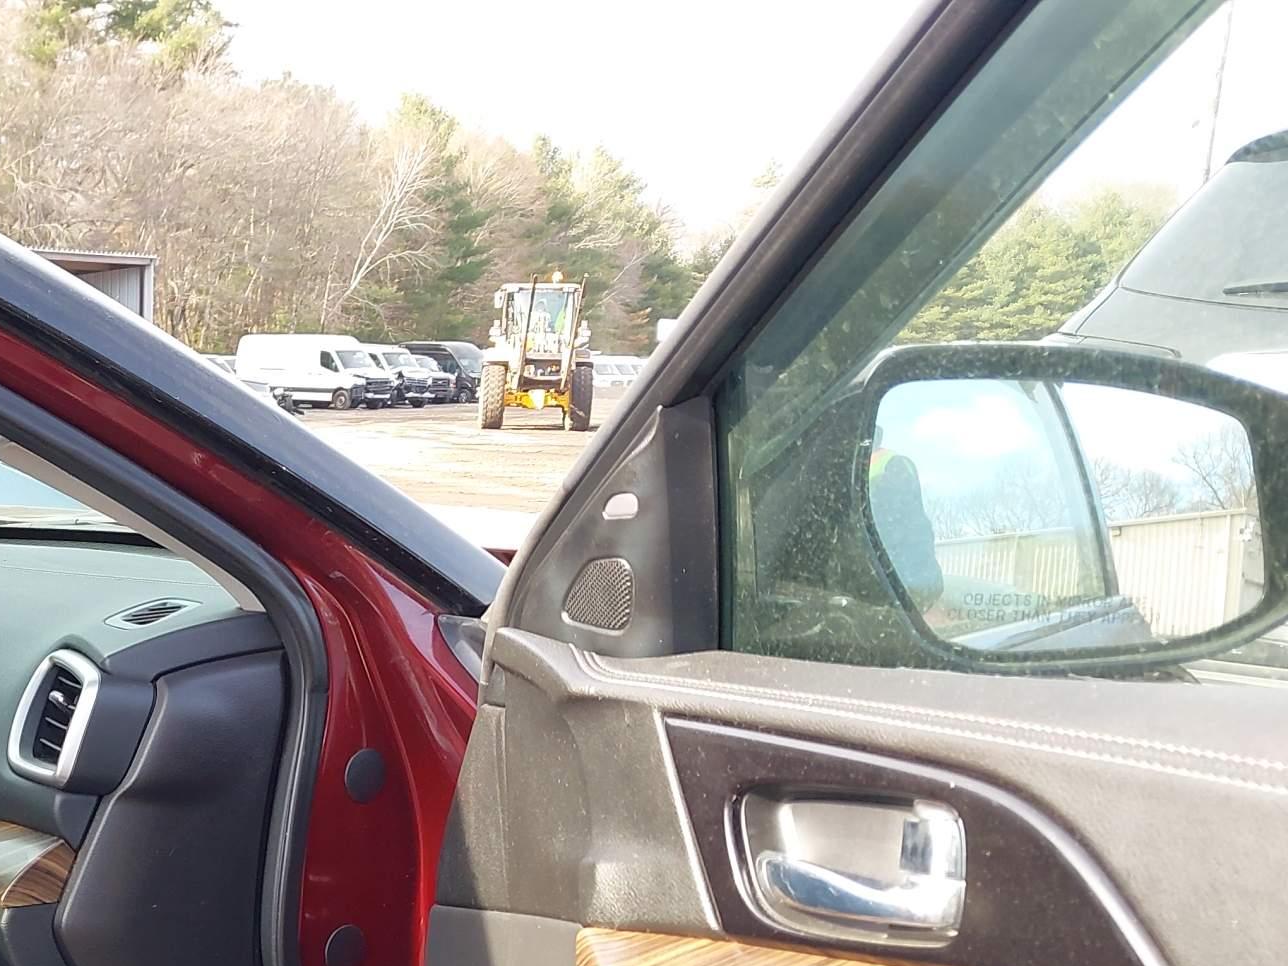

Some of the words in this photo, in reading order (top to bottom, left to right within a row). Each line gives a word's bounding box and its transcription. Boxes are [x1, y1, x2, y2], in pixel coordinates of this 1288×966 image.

[964, 593, 1031, 606] OBJECTS
[1037, 594, 1049, 608] IN
[948, 608, 1005, 621] CLOSER
